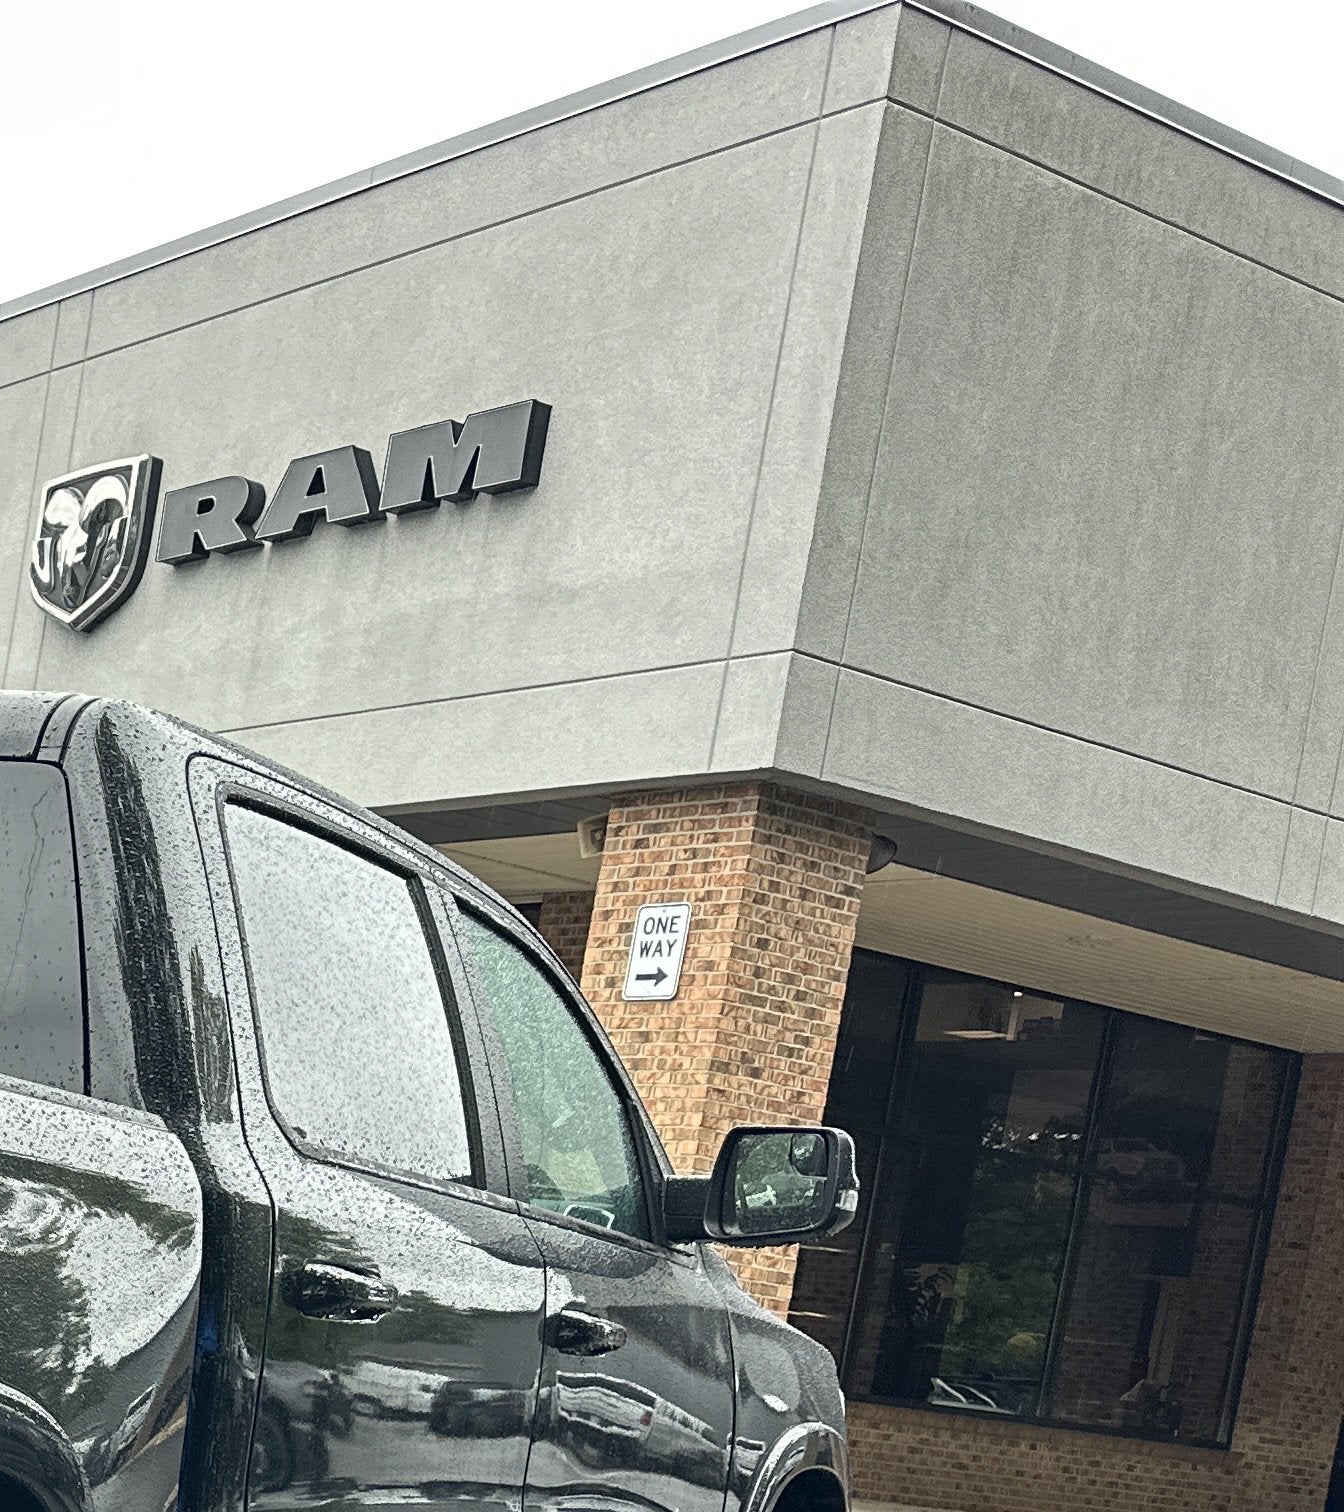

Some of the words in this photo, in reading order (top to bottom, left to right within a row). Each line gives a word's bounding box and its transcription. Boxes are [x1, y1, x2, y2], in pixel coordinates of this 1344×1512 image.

[156, 399, 552, 565] RAM
[643, 915, 682, 935] ONE
[639, 939, 678, 958] WAY
